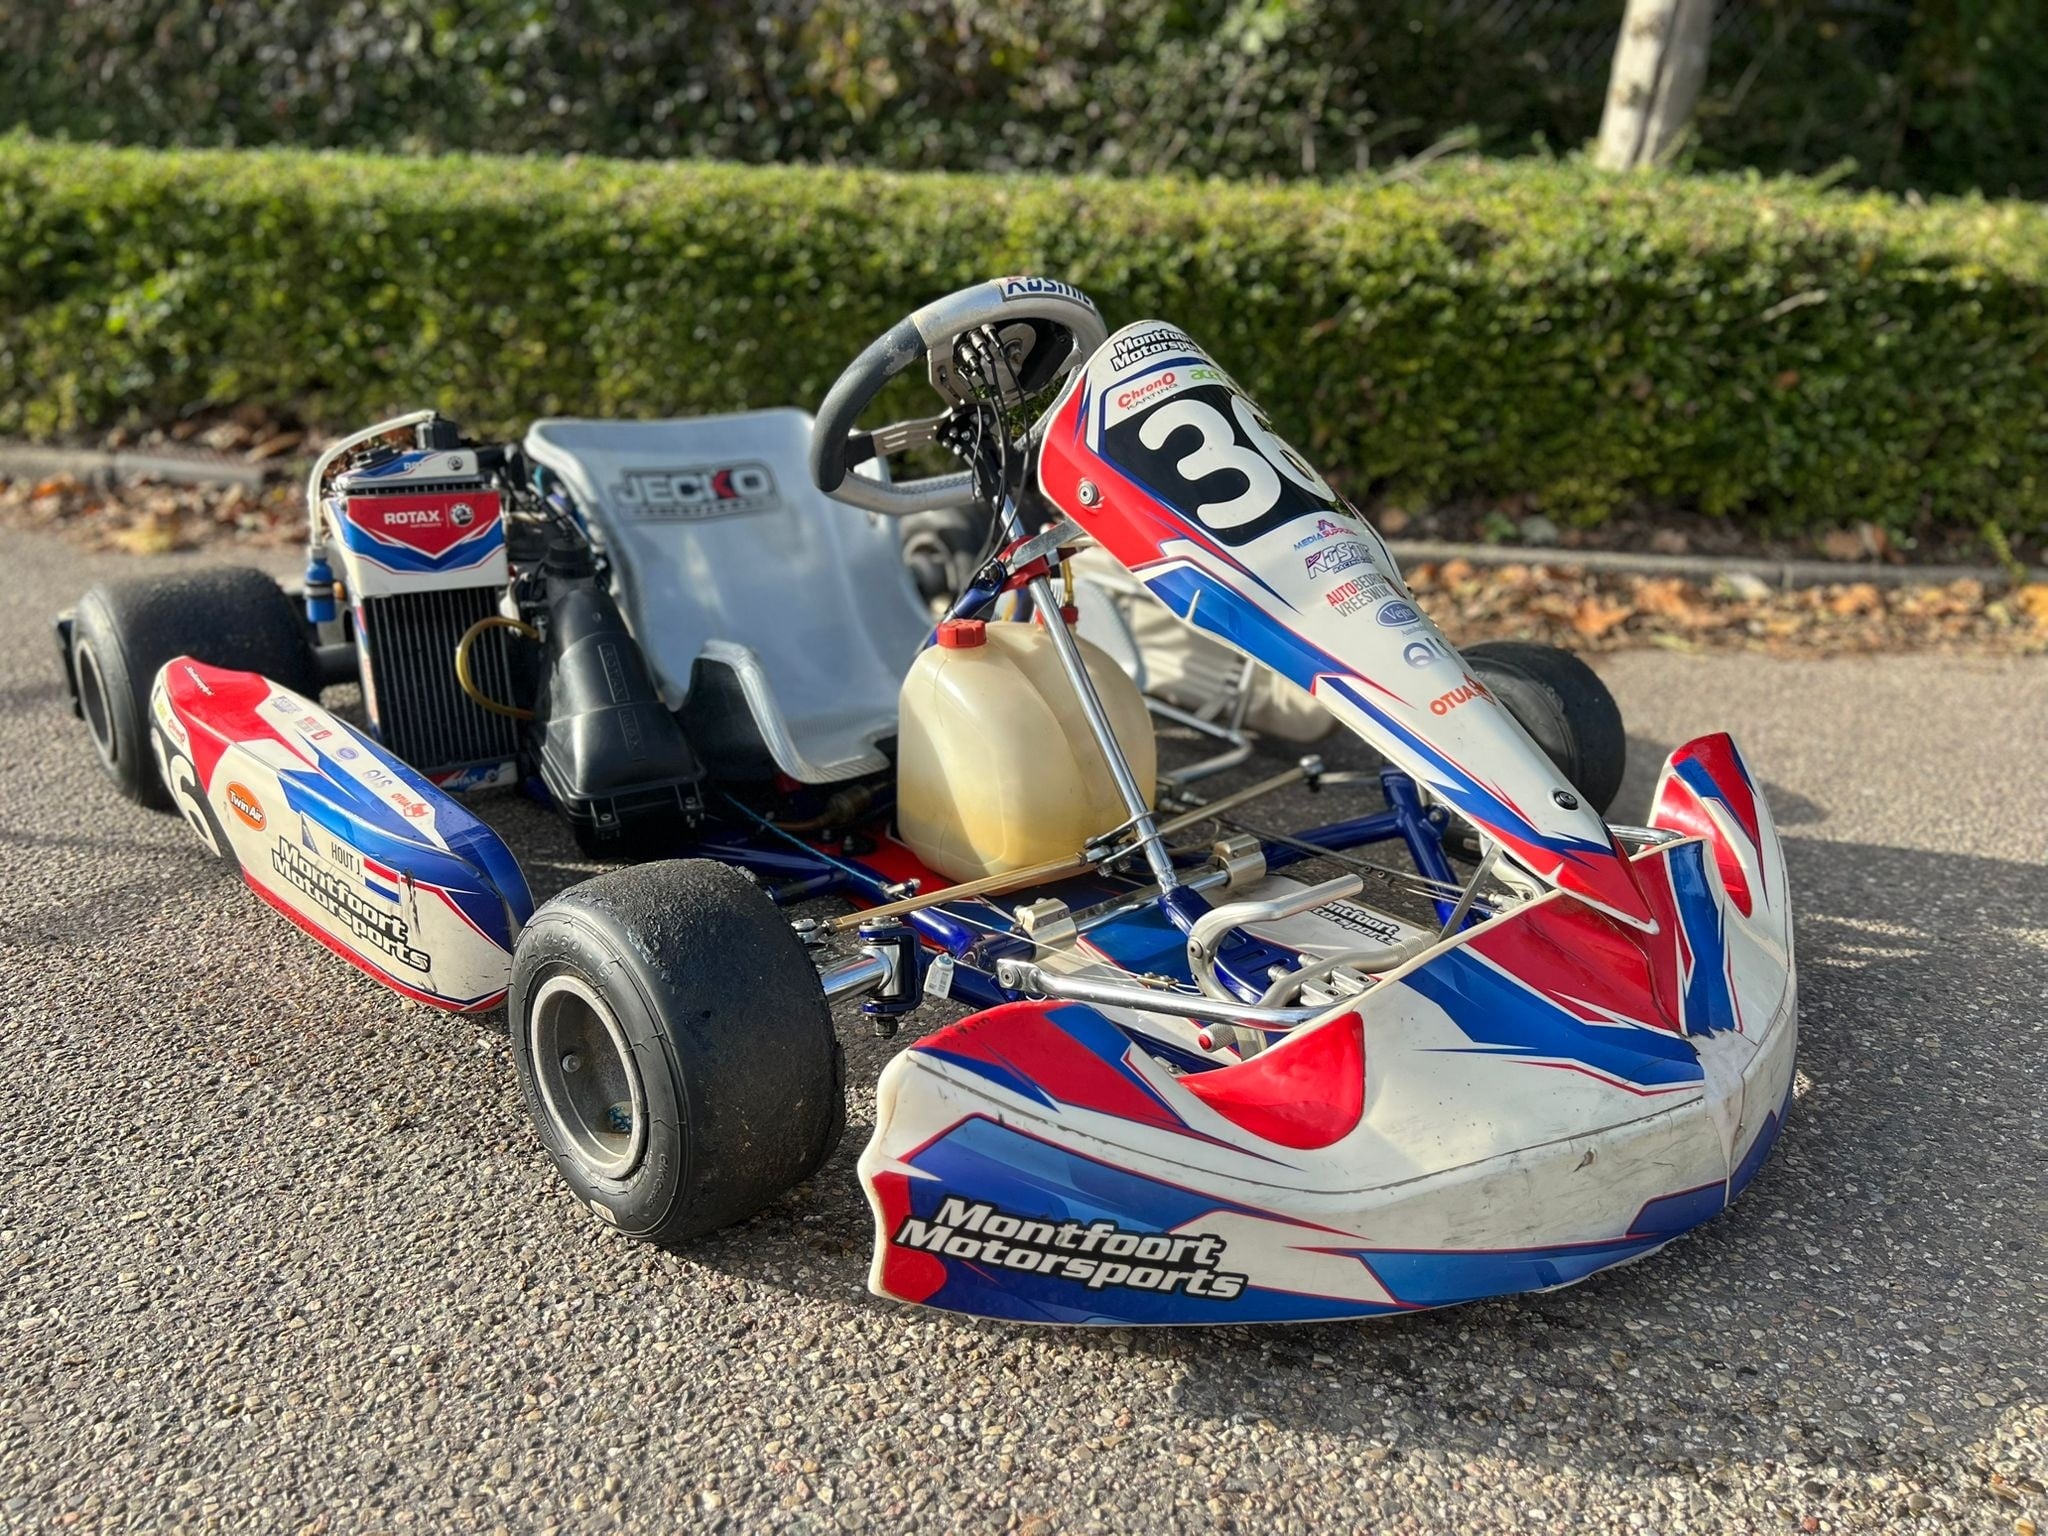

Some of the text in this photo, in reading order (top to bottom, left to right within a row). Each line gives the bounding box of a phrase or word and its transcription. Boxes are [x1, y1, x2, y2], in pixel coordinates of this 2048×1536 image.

[1110, 340, 1199, 372] Motorspo
[1114, 329, 1196, 357] Montfoo
[1127, 383, 1178, 410] KARTING
[610, 469, 771, 505] JECKO
[384, 511, 440, 525] ROTAX
[229, 789, 264, 824] Twin Air
[331, 841, 353, 872] HOUT
[279, 835, 408, 942] Montfoort
[271, 848, 431, 973] Motorsports
[1320, 902, 1401, 936] ntfoort
[933, 1195, 1225, 1266] Montfoort
[893, 1216, 1248, 1301] Motorsports
